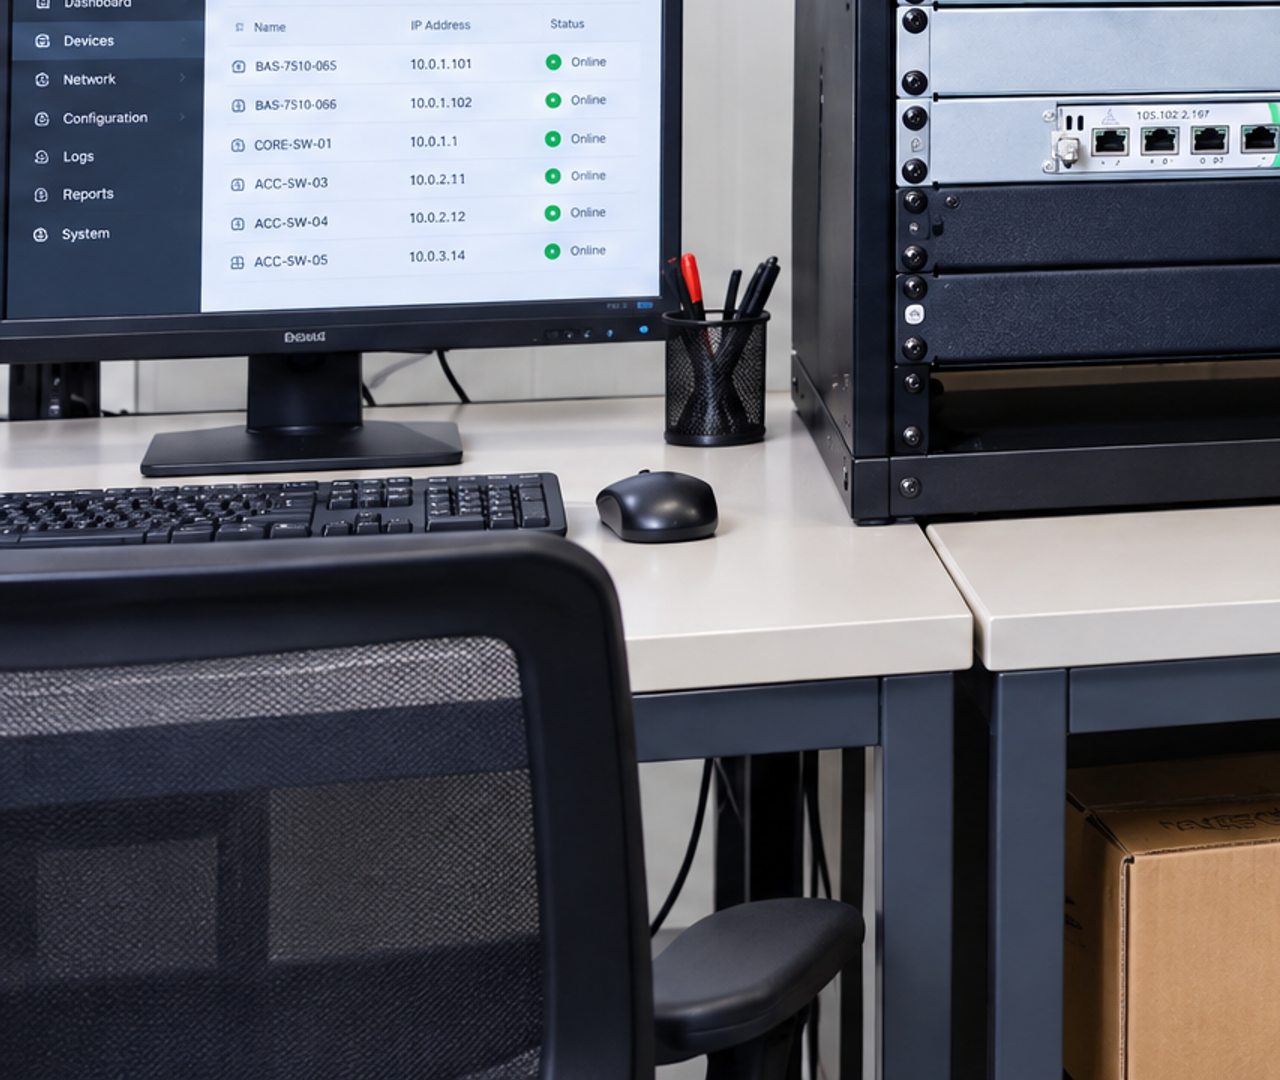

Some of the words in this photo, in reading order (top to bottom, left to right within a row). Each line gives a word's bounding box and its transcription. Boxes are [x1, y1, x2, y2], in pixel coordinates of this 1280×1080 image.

[254, 22, 287, 33] Name
[410, 19, 423, 31] IP
[424, 19, 471, 31] Address
[550, 18, 585, 30] Status
[64, 34, 115, 47] Devices
[410, 58, 472, 71] 10.0.1.101
[571, 56, 607, 68] Online
[63, 73, 117, 86] Network
[410, 96, 473, 109] 10.0.1.102
[570, 94, 607, 107] Online
[62, 111, 149, 128] Configuration
[253, 137, 332, 152] CORE-SW-01
[410, 135, 458, 148] 10.0.1.1
[570, 133, 607, 145] Online
[63, 151, 95, 165] Logs
[410, 173, 465, 186] 10.0.2.11
[570, 170, 607, 182] Online
[254, 176, 329, 190] ACC-SW-03
[62, 187, 115, 203] Reports
[409, 210, 466, 224] 10.0.2.12
[570, 206, 607, 219] Online
[253, 215, 329, 230] ACC-SW-04
[61, 227, 110, 243] System
[409, 249, 466, 263] 10.0.3.14
[569, 245, 607, 257] Online
[253, 253, 329, 268] ACC-SW-05
